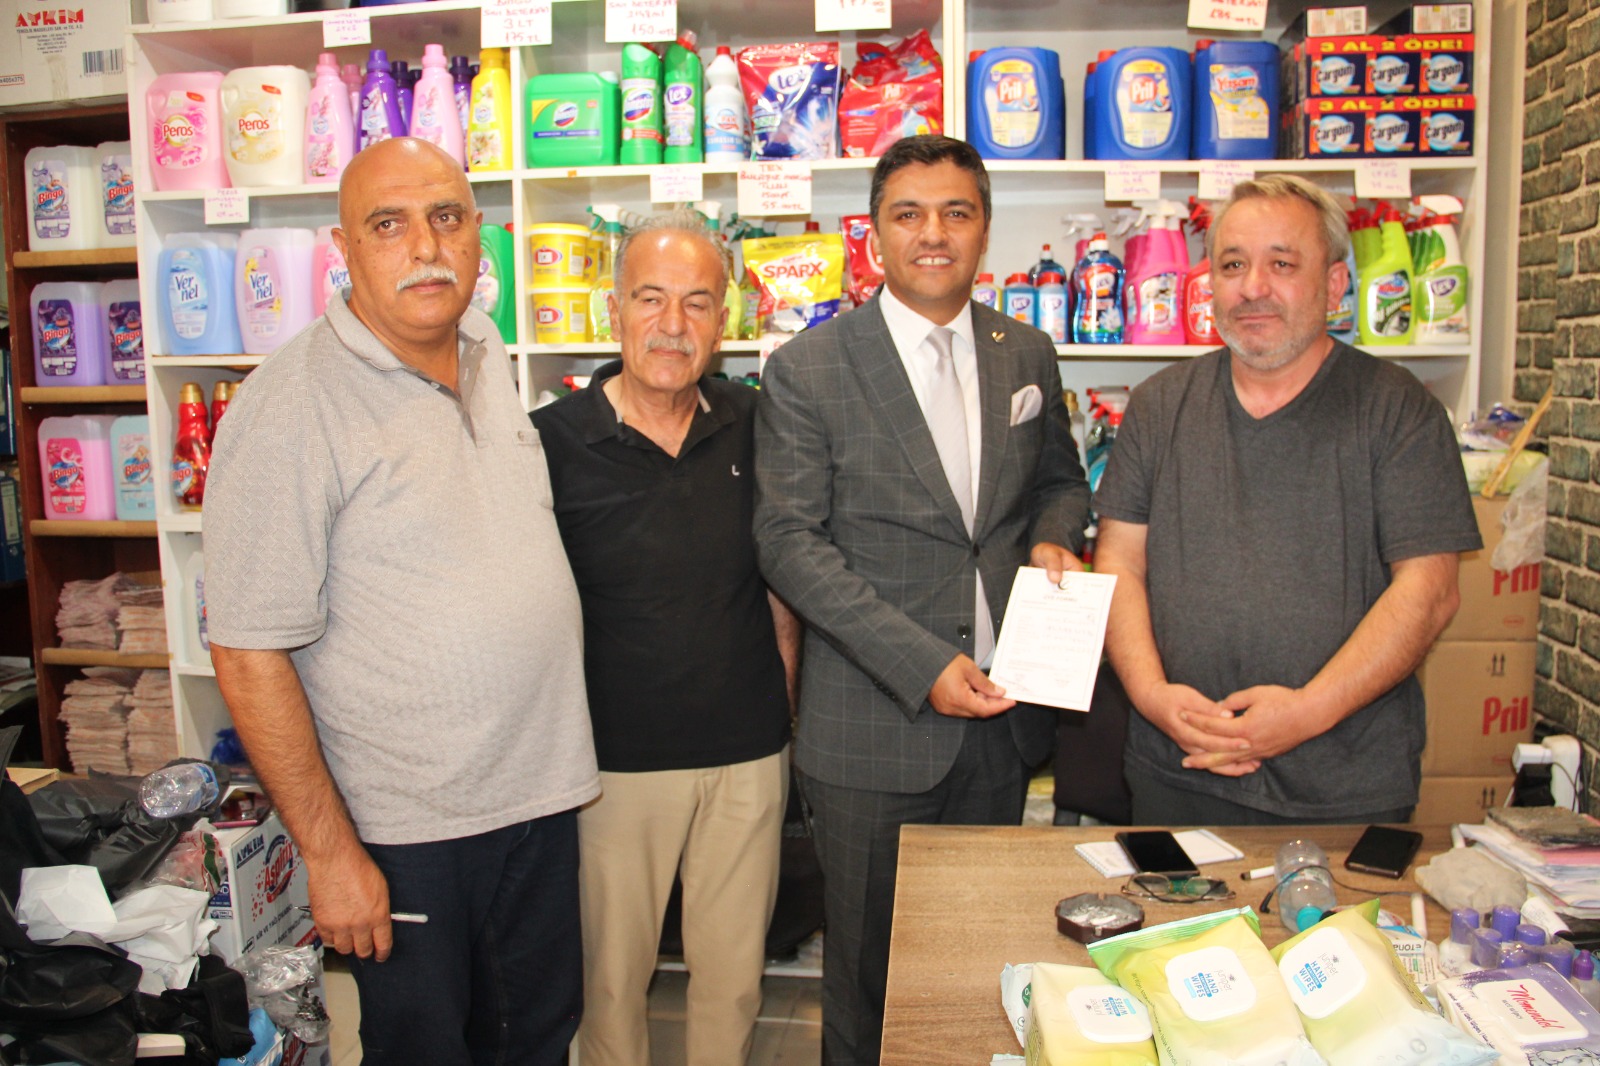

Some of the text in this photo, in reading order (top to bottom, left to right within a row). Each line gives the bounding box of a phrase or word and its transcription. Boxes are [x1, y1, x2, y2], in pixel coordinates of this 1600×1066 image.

[504, 18, 533, 29] 3 LT
[505, 32, 541, 43] 175 TL
[1320, 42, 1335, 51] 3
[1343, 41, 1374, 51] AL
[1404, 38, 1463, 50] ÖDE!
[1000, 80, 1022, 100] Pril
[1132, 79, 1154, 100] Pril
[1319, 101, 1334, 111] 3
[1341, 100, 1372, 110] AL
[1403, 97, 1462, 109] ÖDE!
[163, 124, 193, 136] Peros
[238, 119, 269, 131] Peros
[38, 189, 64, 204] Bingo
[763, 261, 823, 279] SPARX
[175, 275, 194, 290] Ver
[250, 273, 268, 289] Ver
[181, 285, 199, 302] nel
[255, 285, 273, 301] nel
[43, 327, 70, 342] Bingo
[115, 330, 142, 346] Bingo
[53, 466, 78, 481] Bingo
[1482, 696, 1529, 736] Pril
[1299, 967, 1317, 992] WIPES
[1310, 960, 1328, 983] HAND
[1191, 975, 1206, 998] WIPES
[1204, 973, 1219, 994] HAND
[1101, 998, 1115, 1015] HAND
[1114, 997, 1129, 1015] WIPES
